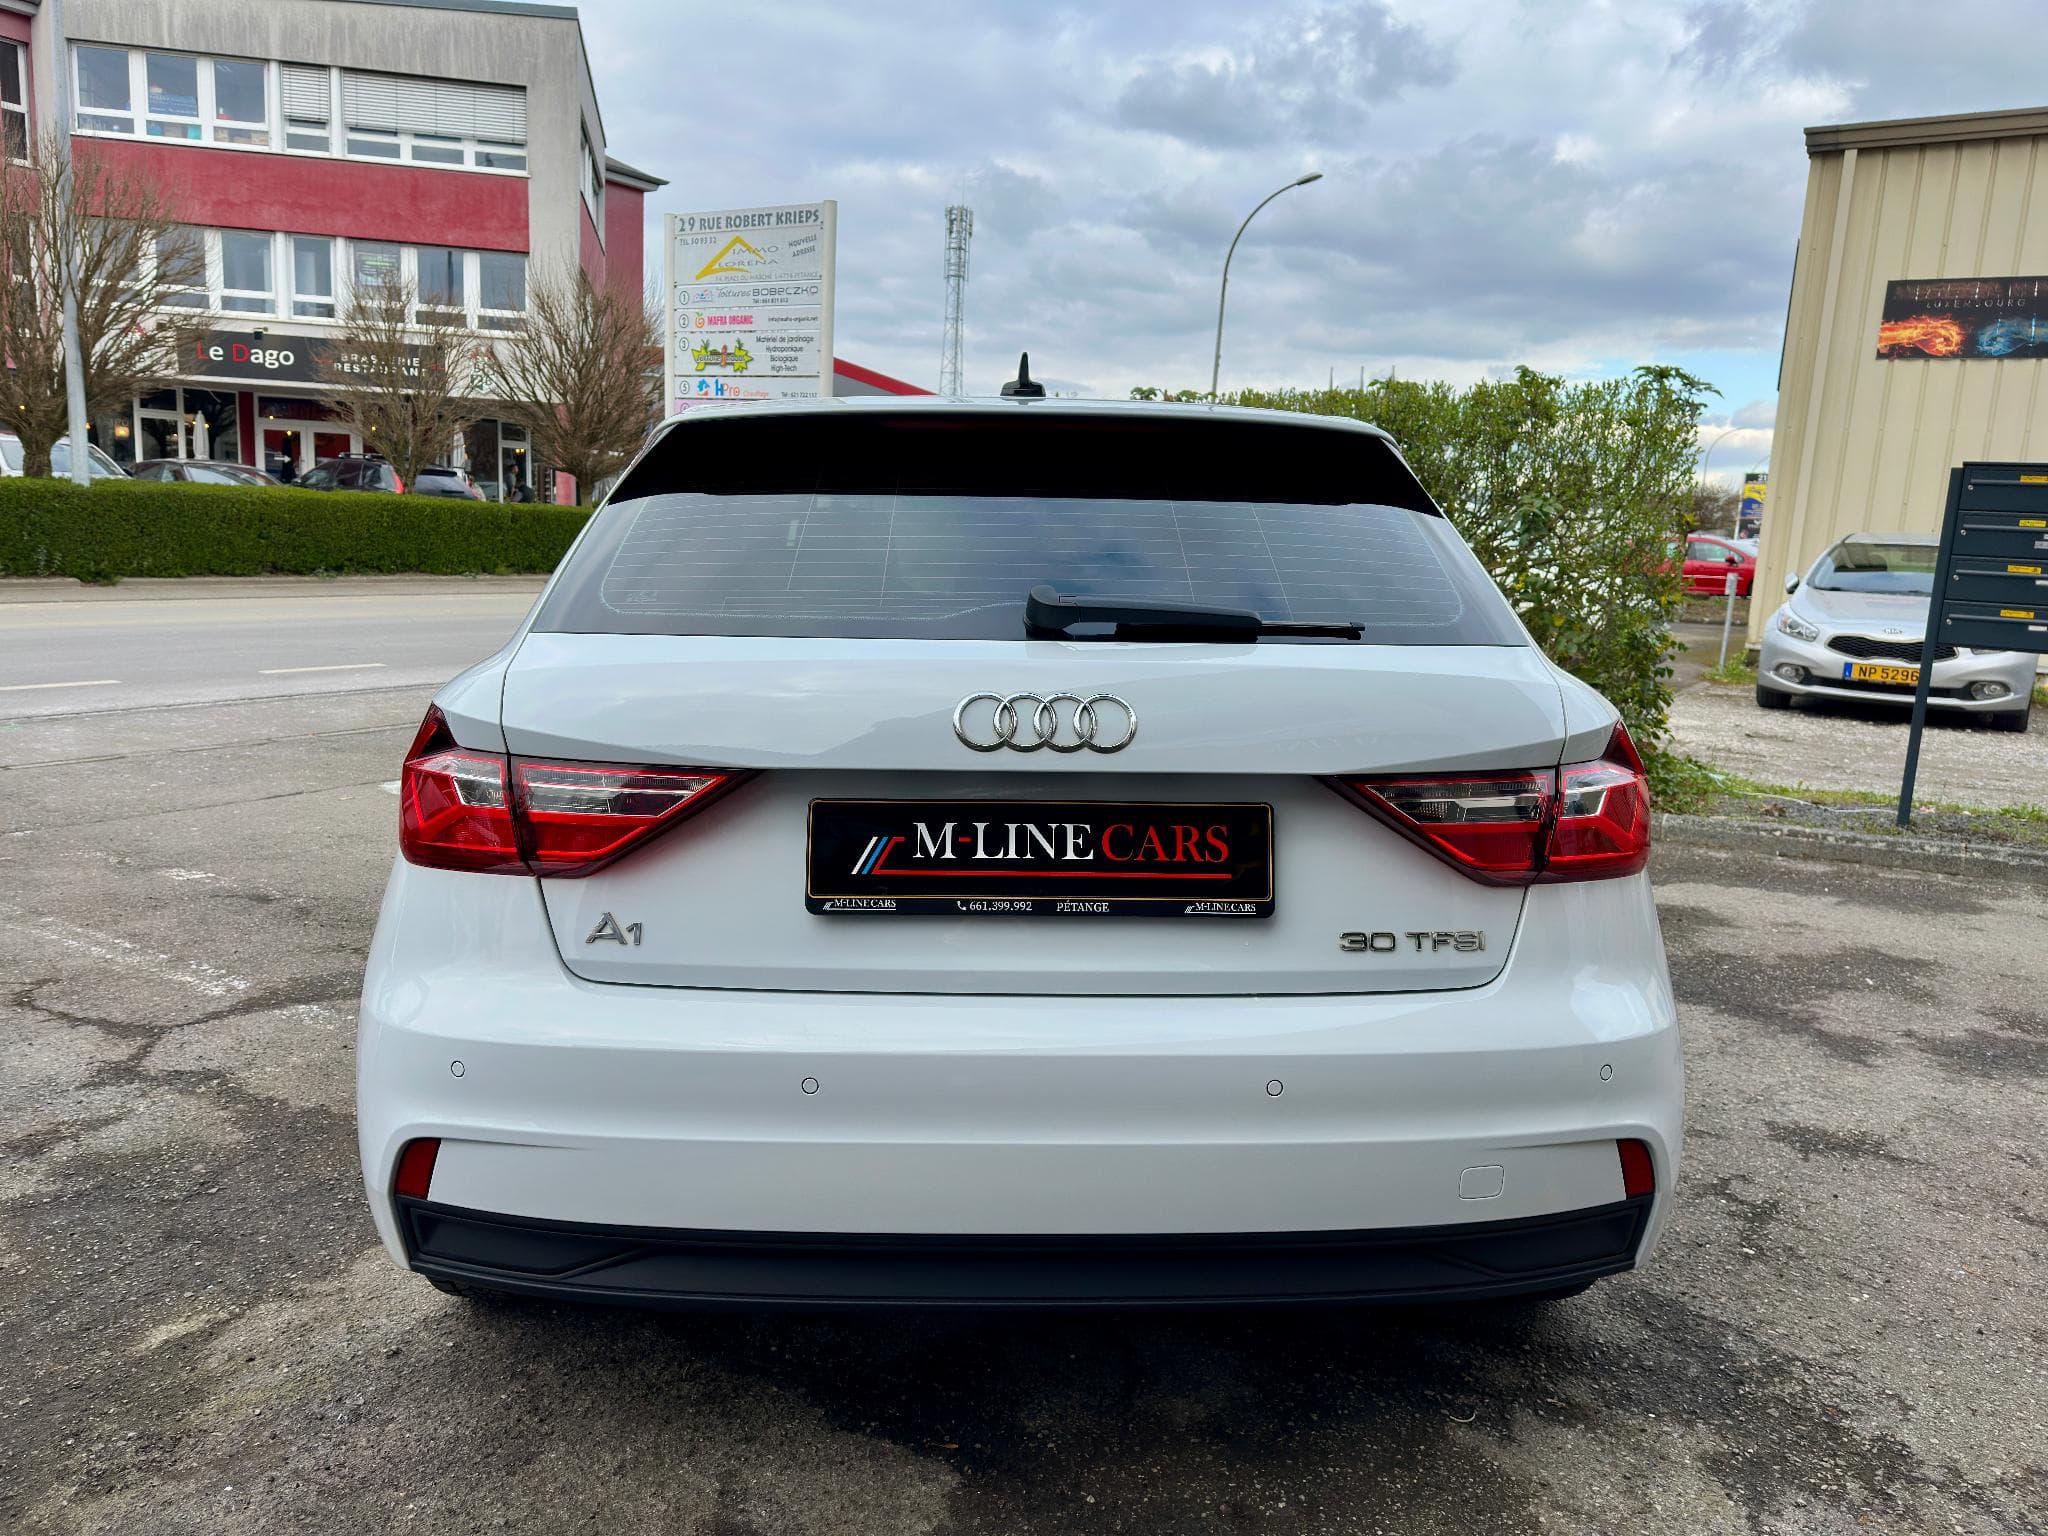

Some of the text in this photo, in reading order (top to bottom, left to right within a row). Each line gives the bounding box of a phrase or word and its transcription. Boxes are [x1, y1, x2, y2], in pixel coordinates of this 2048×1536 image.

[700, 216, 722, 231] RUE
[725, 213, 773, 229] ROBERT
[775, 209, 820, 226] KRIEPS
[788, 234, 817, 248] NOUVELLE
[732, 245, 779, 255] IMMO
[792, 245, 816, 257] ADRESSE
[718, 259, 778, 268] LORENA
[716, 287, 752, 298] Toitures
[196, 342, 295, 368] Le Dago
[770, 355, 799, 363] Biologique
[1858, 666, 1920, 681] NP 5296
[912, 822, 1230, 863] M-LINE CARS
[834, 899, 897, 908] M-LINE CARS
[969, 901, 1033, 911] 661.399.992
[1056, 900, 1110, 912] PÉTANGE
[1195, 902, 1256, 912] M-LINE CARS
[586, 912, 642, 945] A1
[1339, 931, 1486, 951] 30 TFSI
